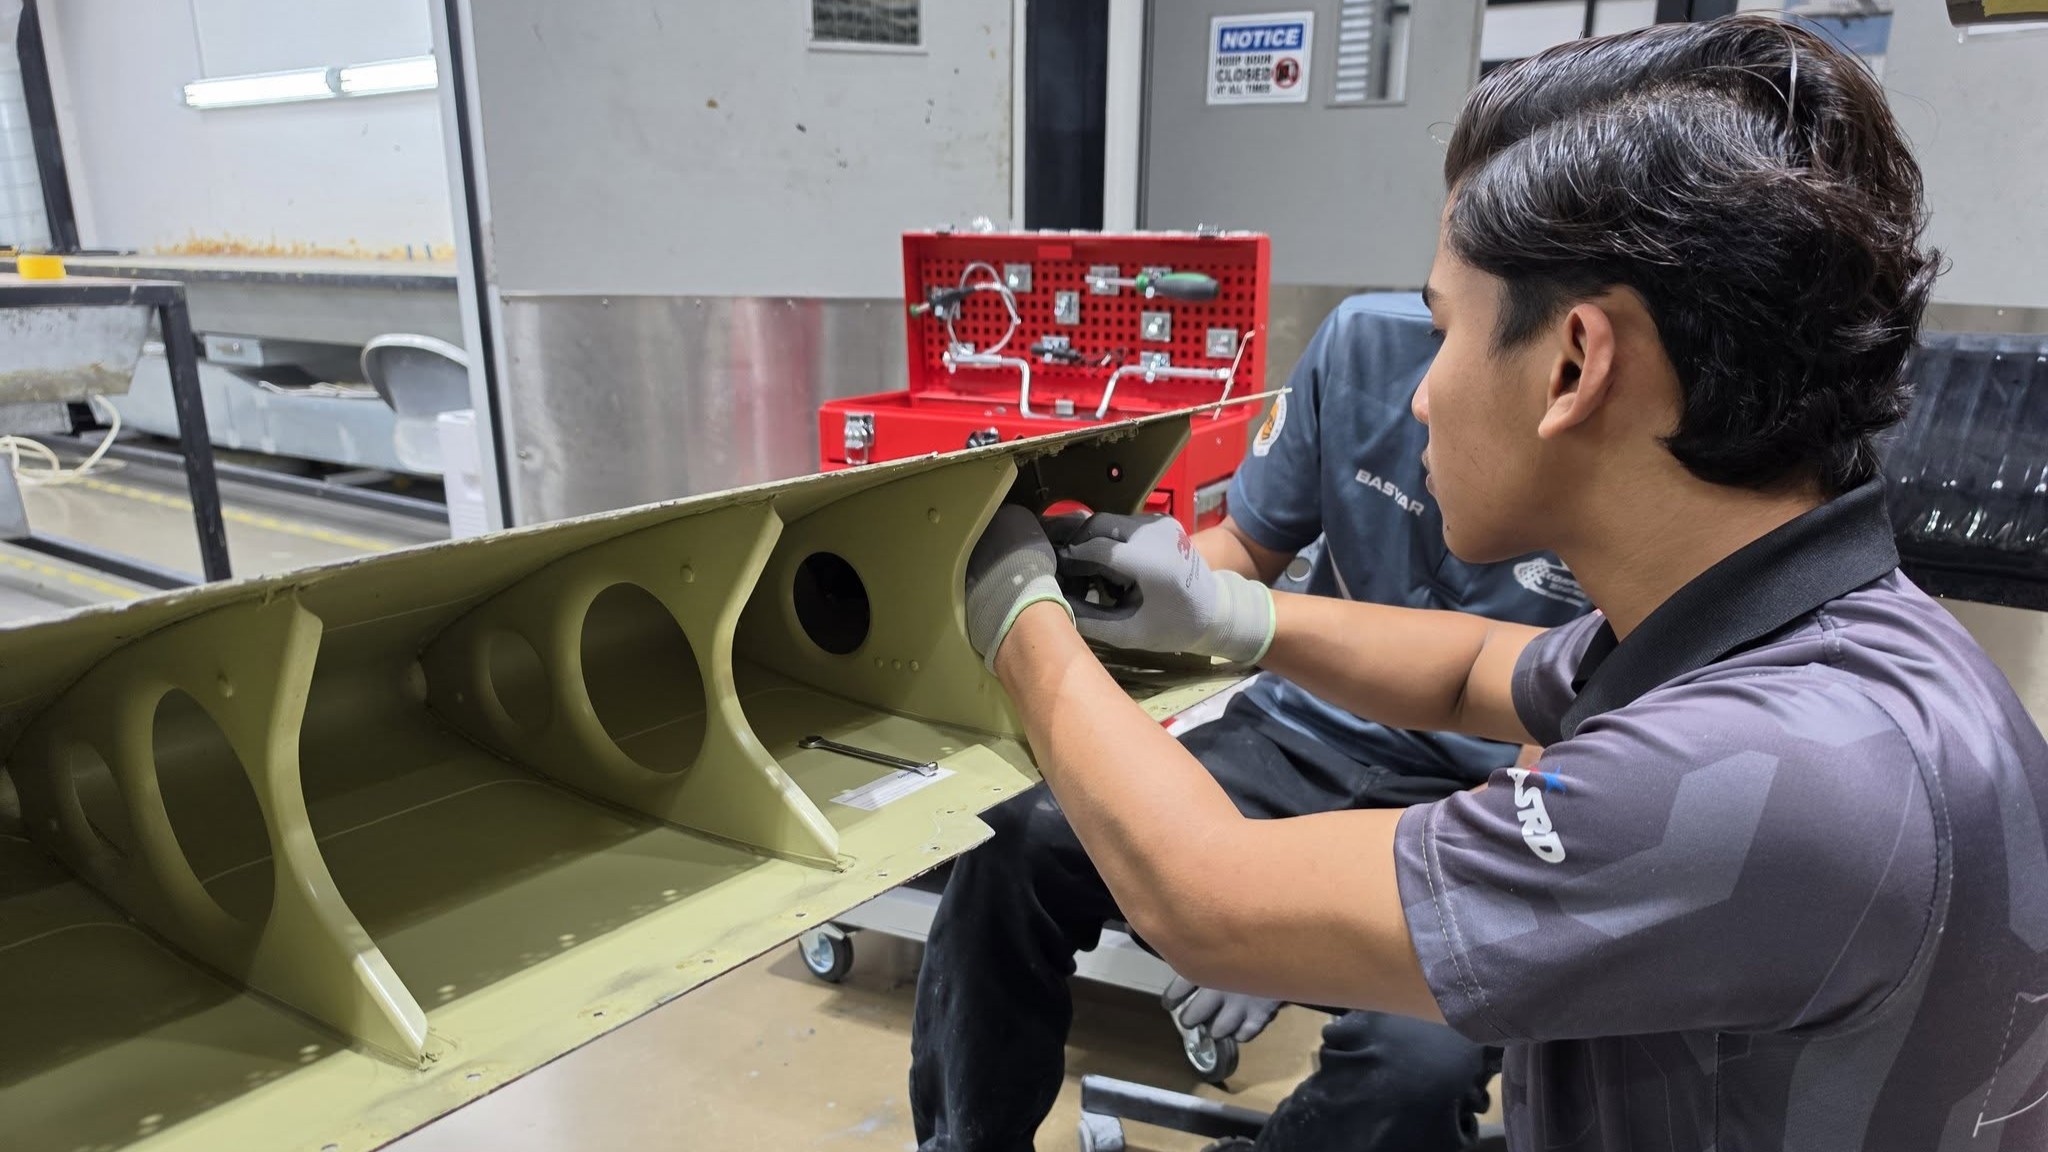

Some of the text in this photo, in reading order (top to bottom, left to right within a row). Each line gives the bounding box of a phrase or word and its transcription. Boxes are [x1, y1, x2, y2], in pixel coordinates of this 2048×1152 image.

[1222, 28, 1301, 49] NOTICE
[1216, 67, 1271, 82] CLOSED
[1355, 468, 1425, 516] BASYAR
